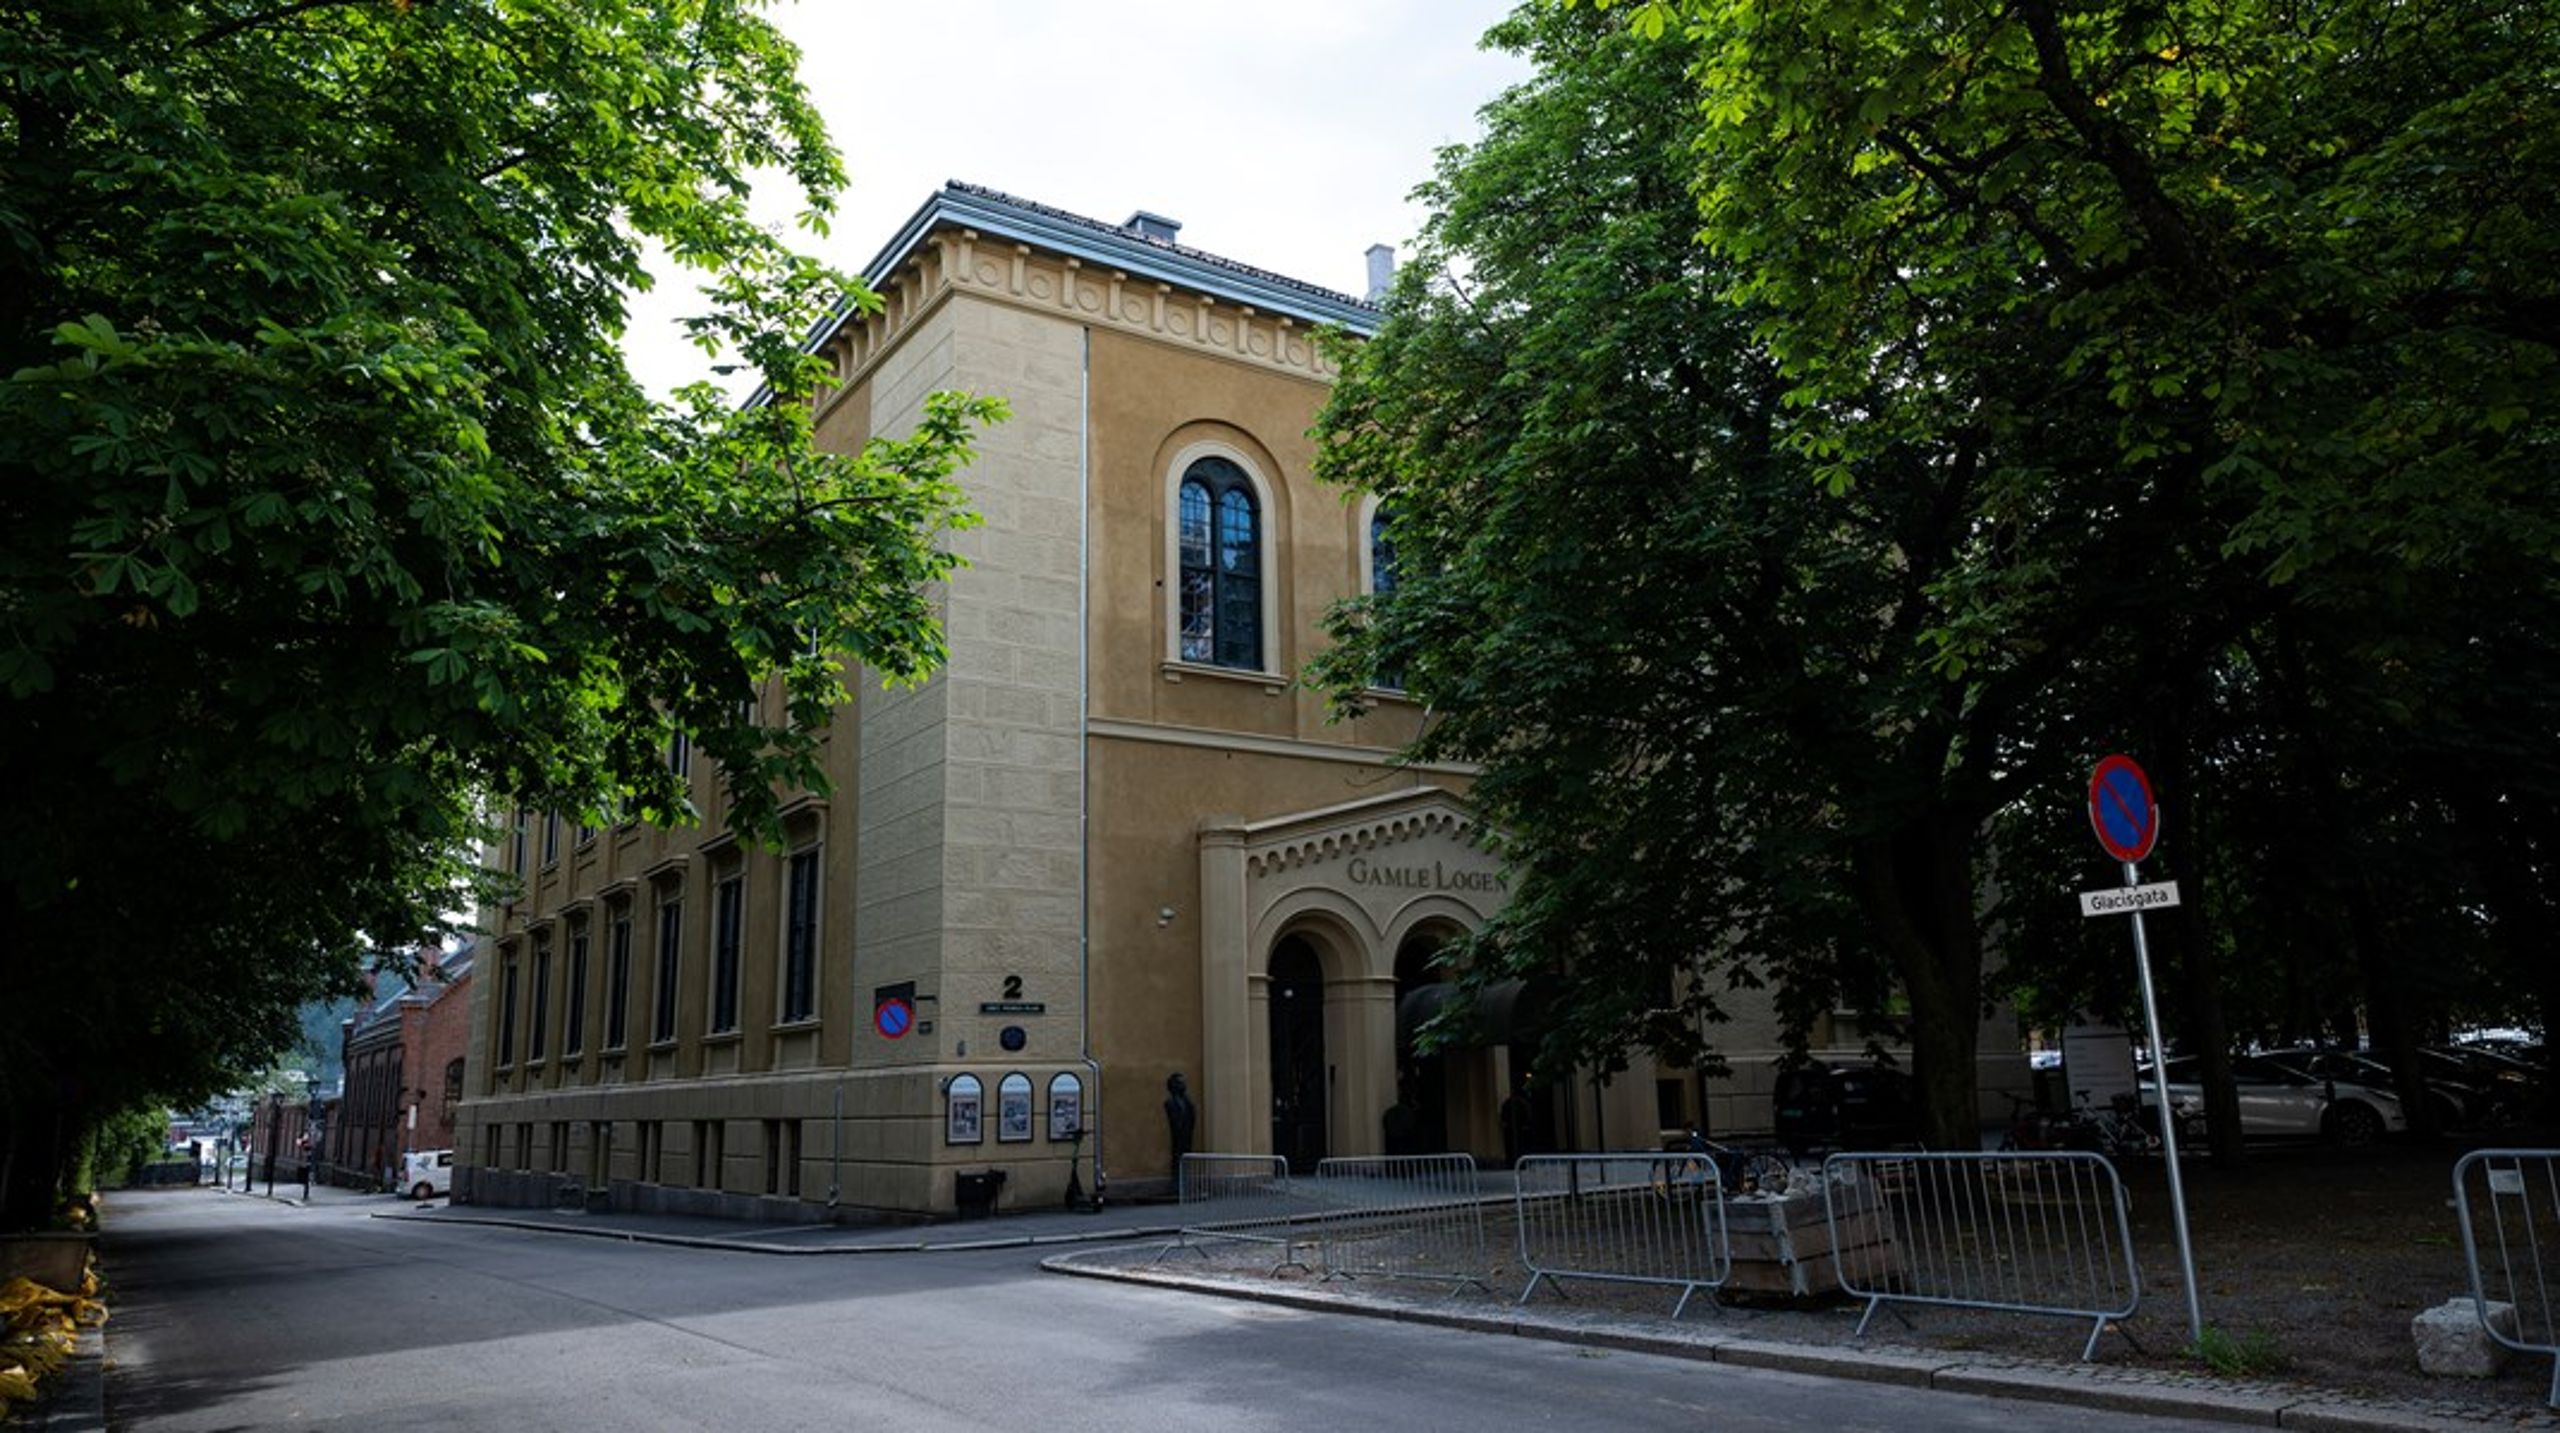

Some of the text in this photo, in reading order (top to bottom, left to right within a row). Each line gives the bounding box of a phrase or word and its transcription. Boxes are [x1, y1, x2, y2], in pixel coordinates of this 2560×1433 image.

[1348, 857, 1431, 888] GAMLE
[2091, 889, 2168, 910] Glacisgata
[1003, 975, 1023, 999] 2
